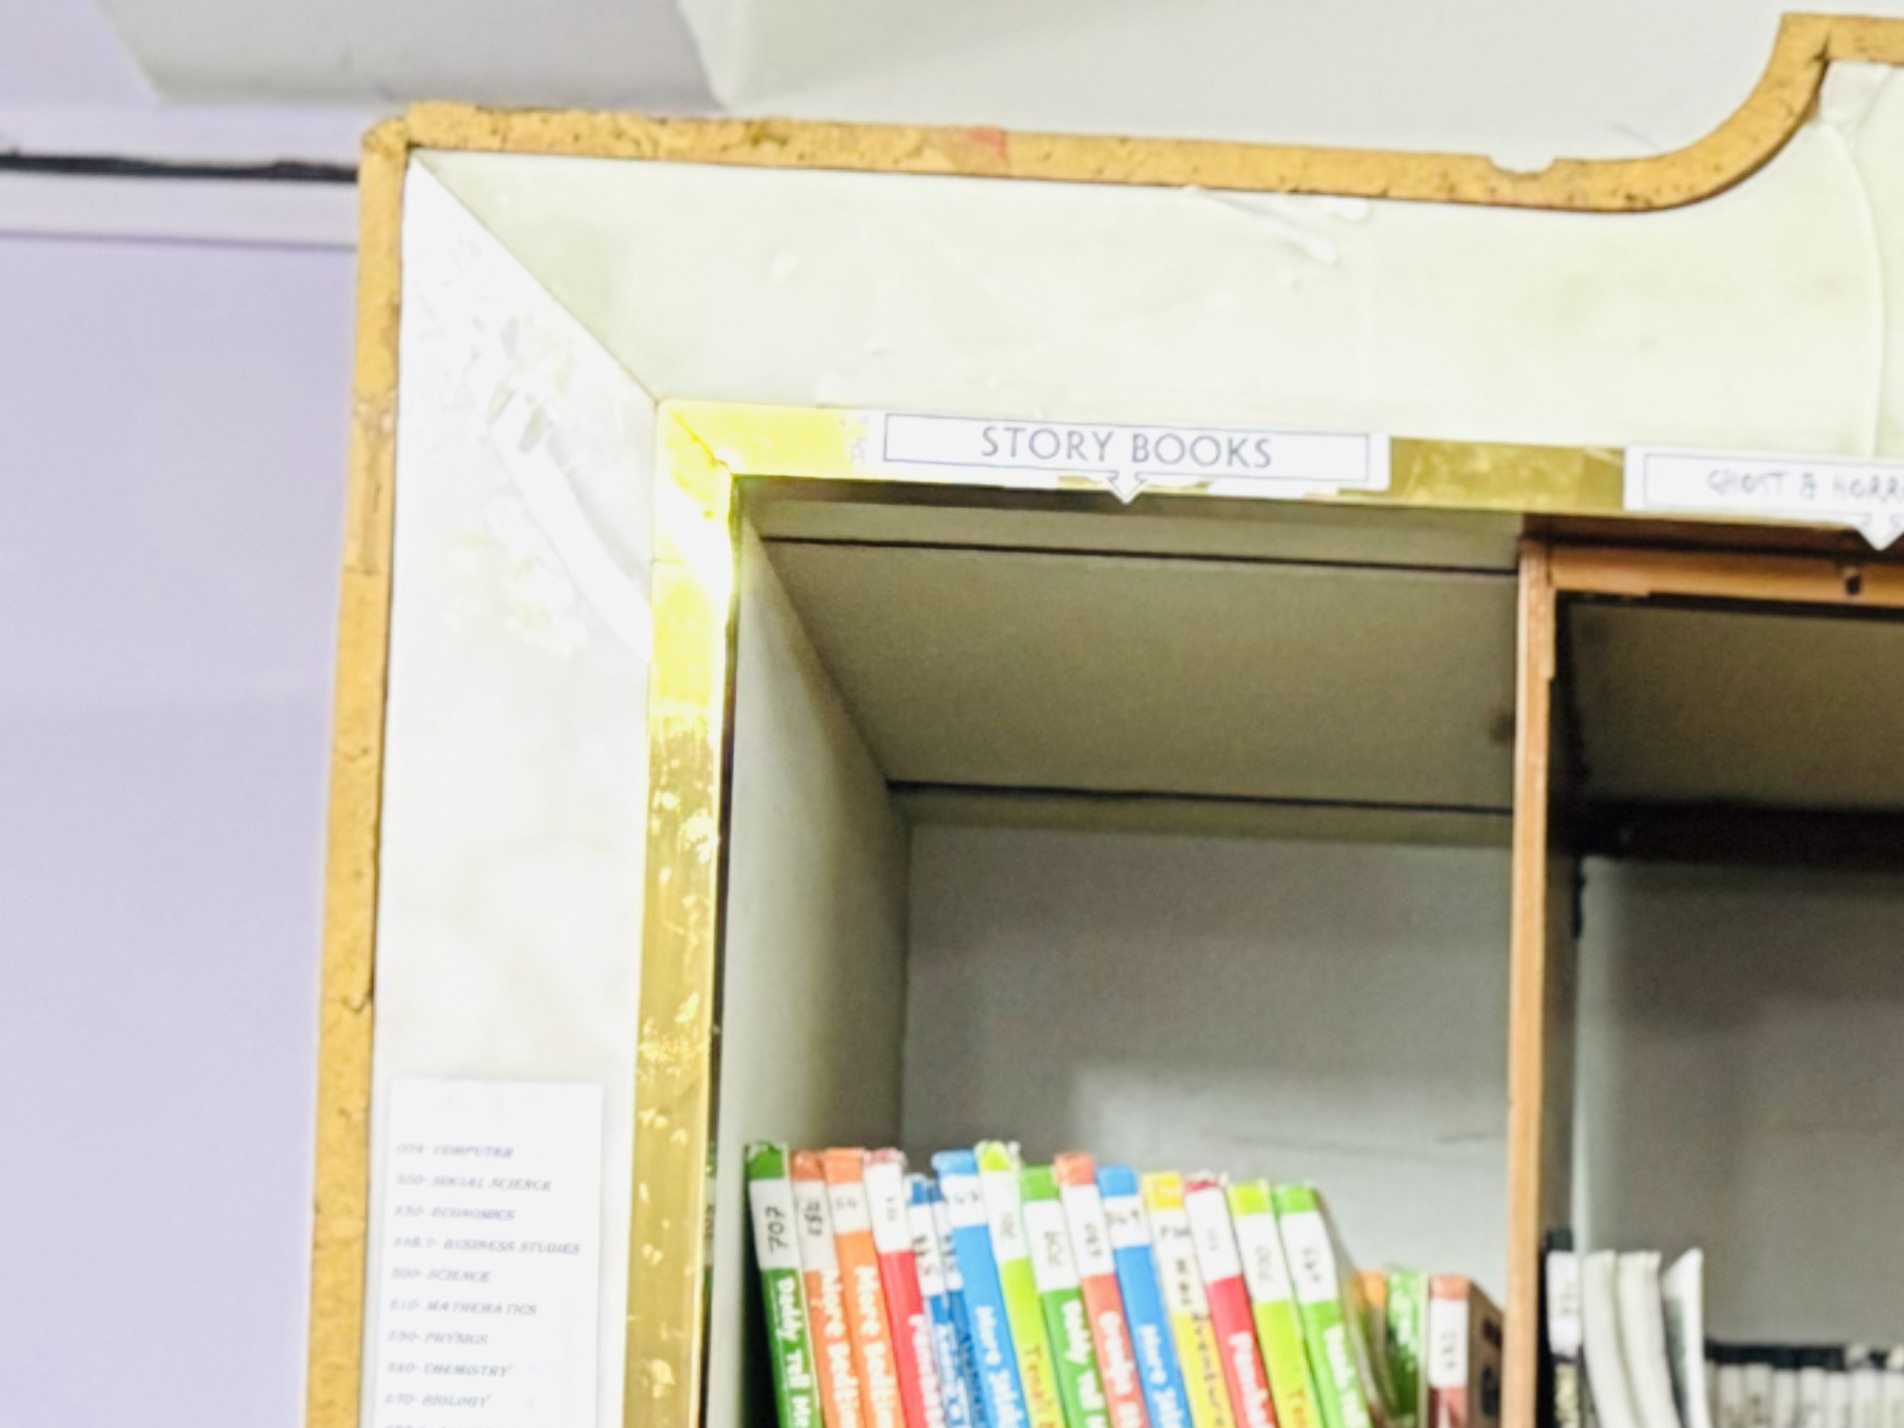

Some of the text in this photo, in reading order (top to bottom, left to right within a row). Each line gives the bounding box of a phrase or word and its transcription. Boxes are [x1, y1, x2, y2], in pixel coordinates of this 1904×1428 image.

[980, 425, 1273, 469] STORY BOOKS
[1707, 468, 1790, 496] GHOST
[854, 1265, 880, 1338] More
[975, 1305, 1001, 1365] More
[1138, 1324, 1167, 1384] More
